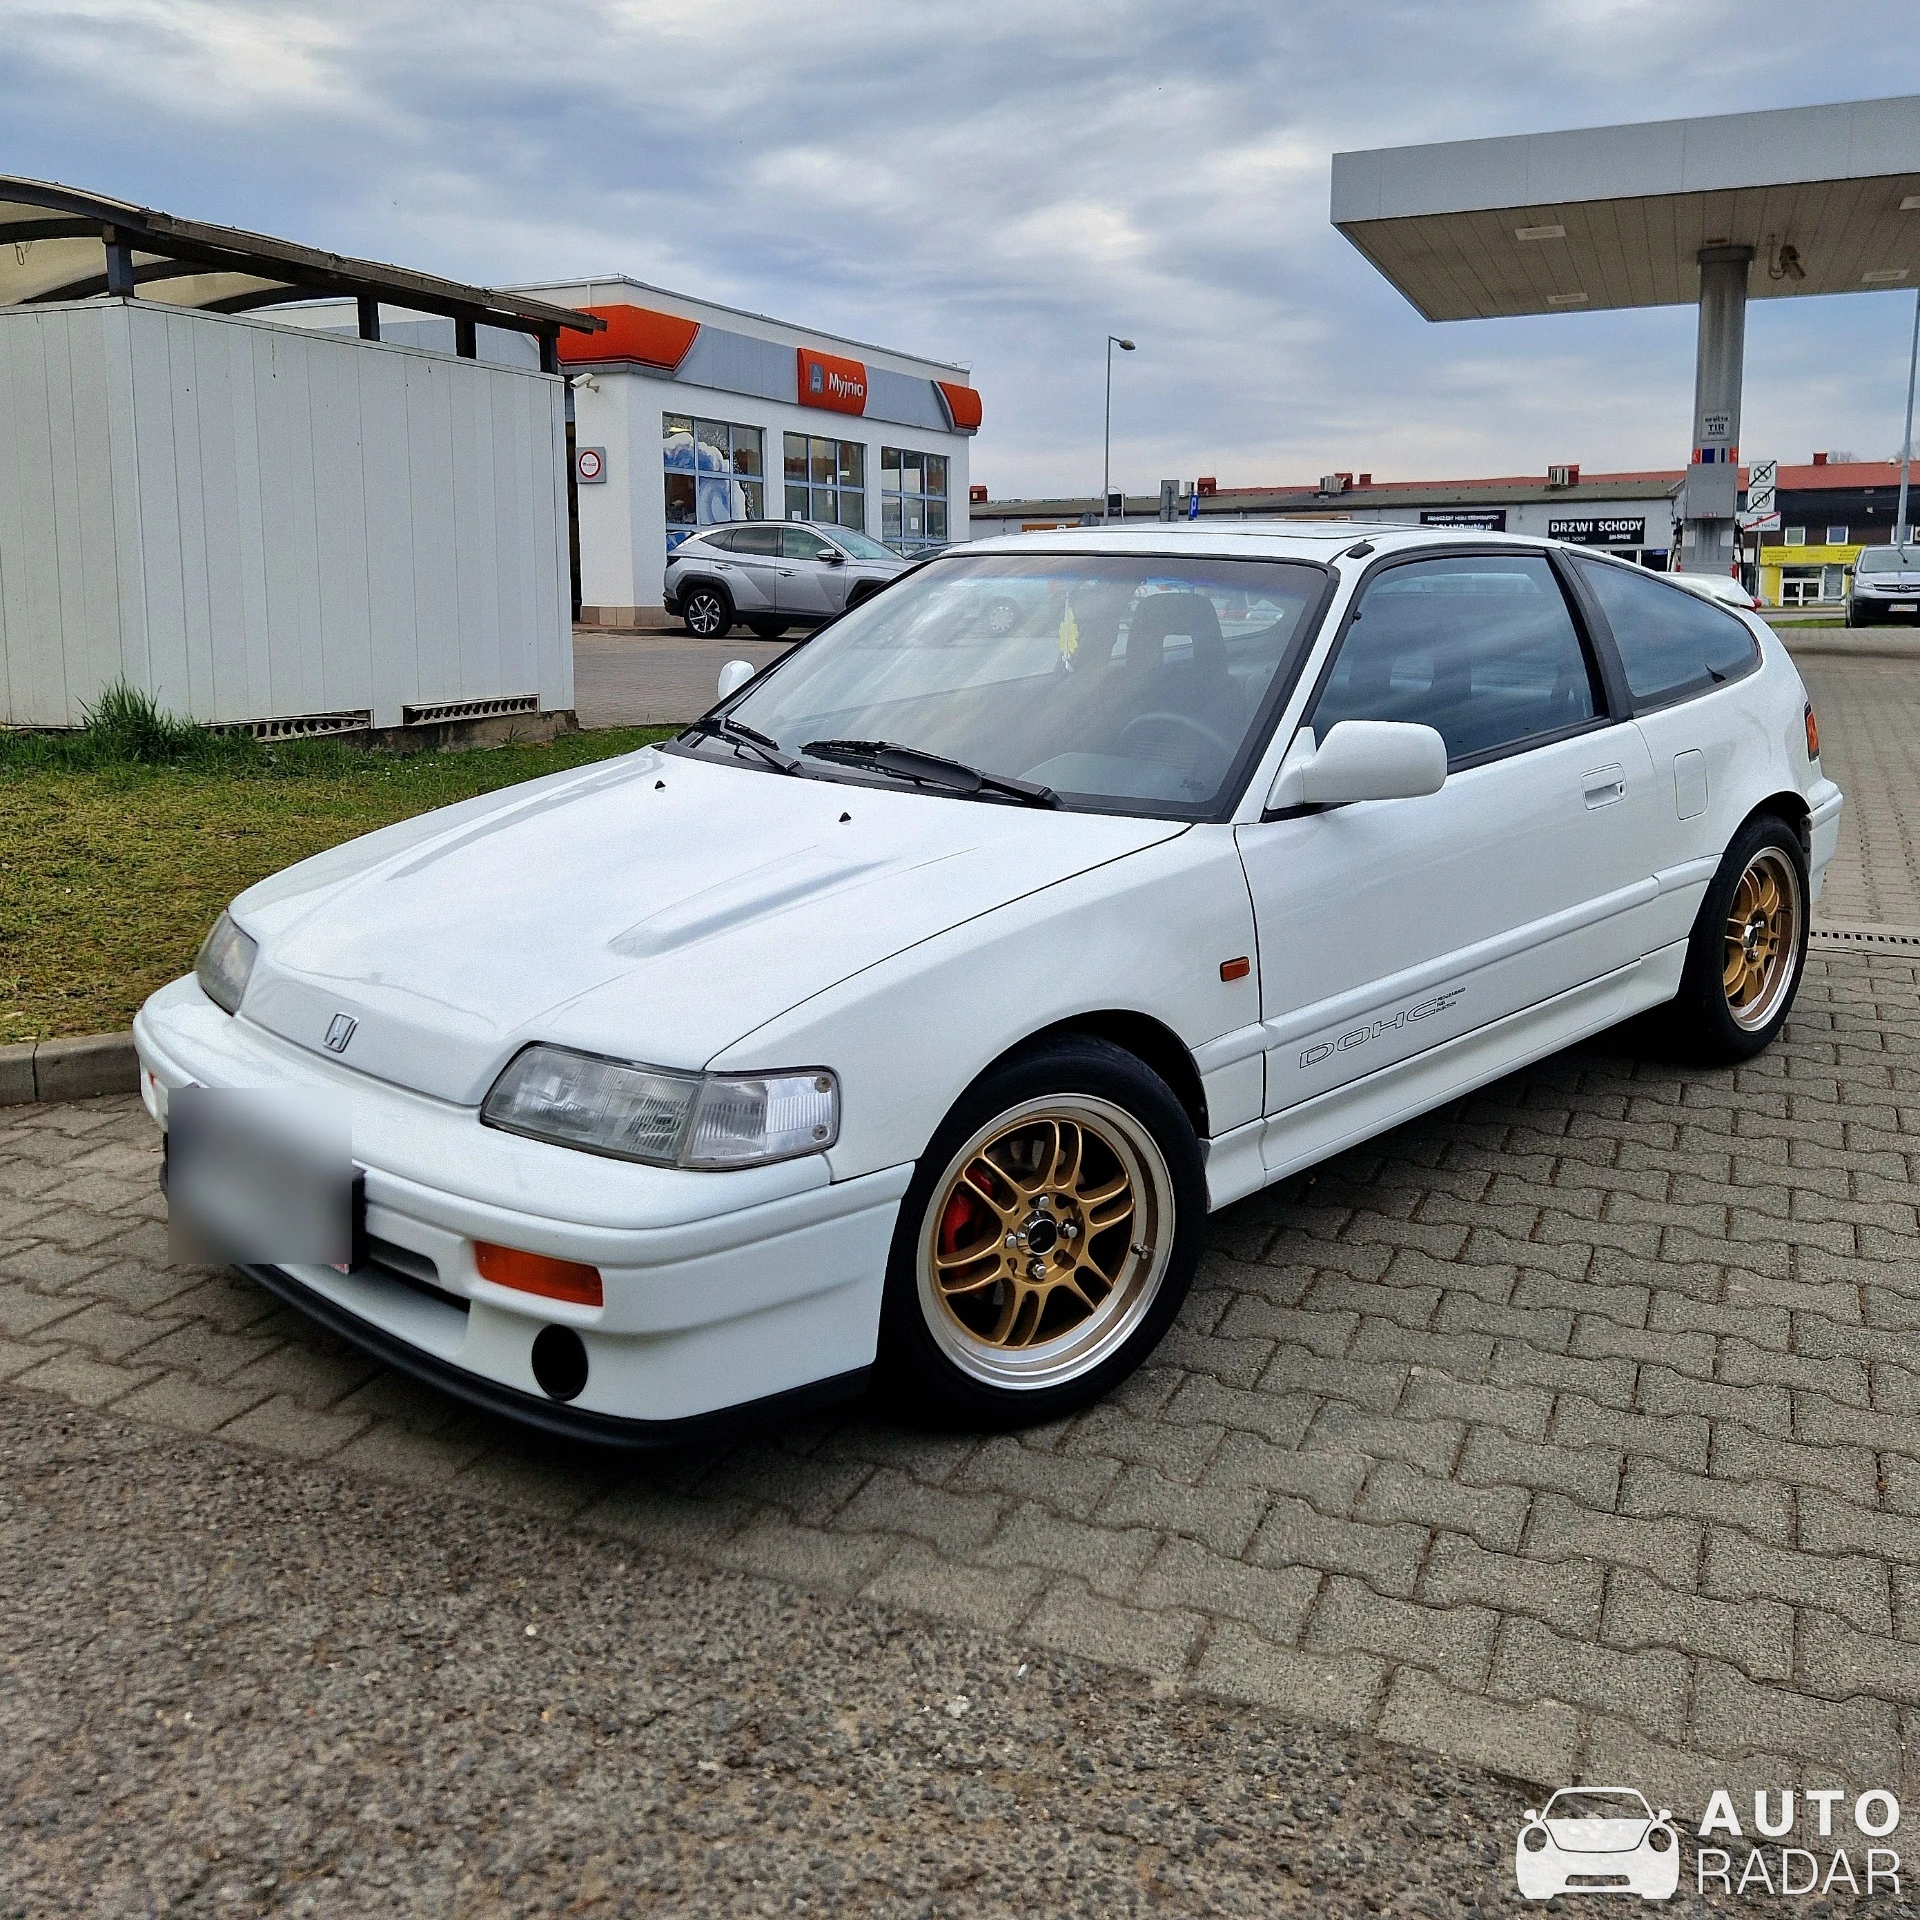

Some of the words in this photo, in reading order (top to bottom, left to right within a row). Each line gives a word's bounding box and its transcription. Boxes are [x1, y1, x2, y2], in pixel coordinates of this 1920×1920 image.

[828, 372, 864, 399] Myjnia
[1708, 423, 1725, 431] TIR
[1550, 521, 1594, 532] DRZWI
[1598, 520, 1643, 532] SCHODY
[1299, 998, 1437, 1069] DOHC
